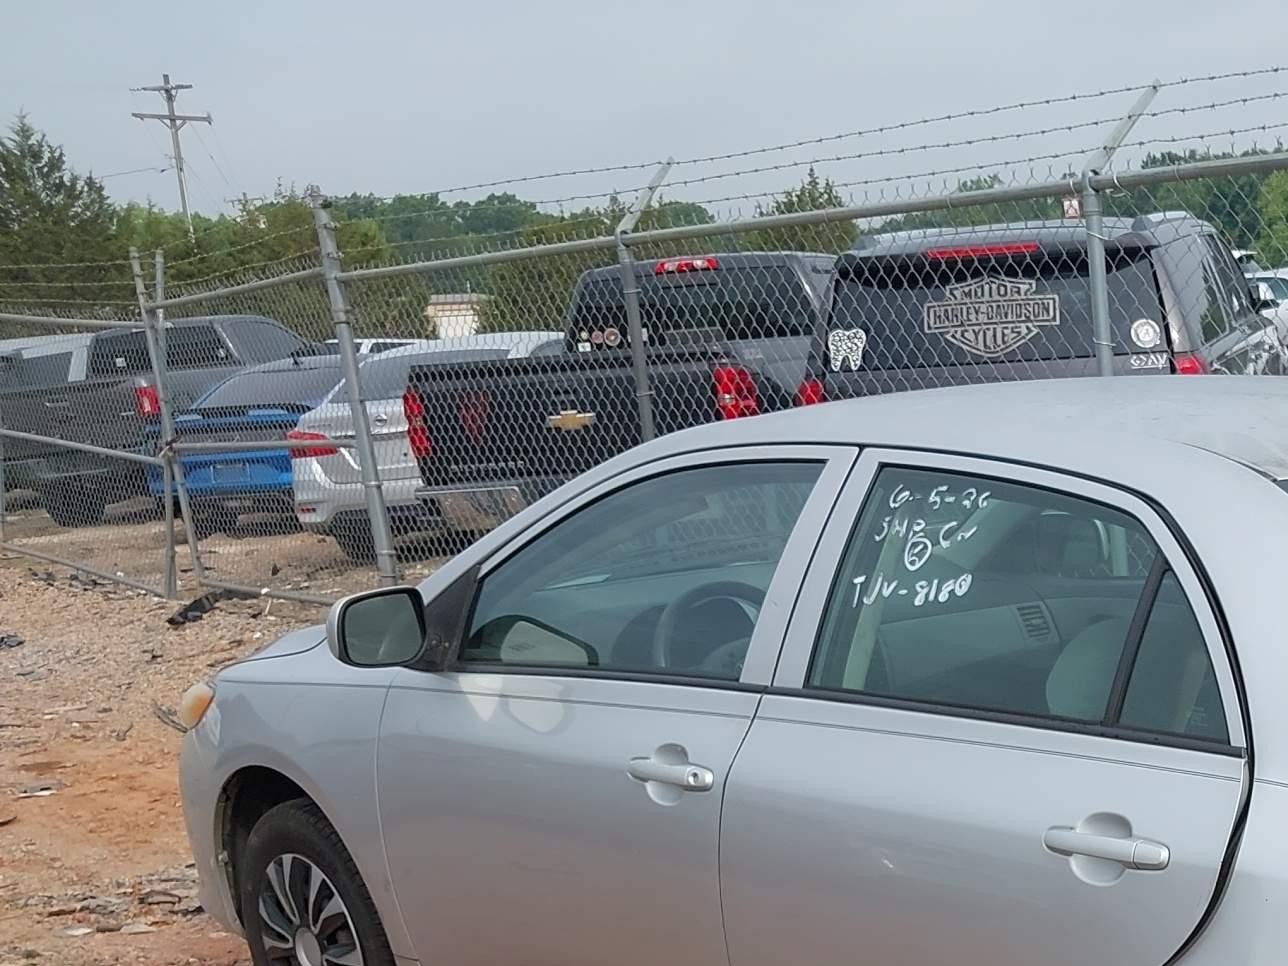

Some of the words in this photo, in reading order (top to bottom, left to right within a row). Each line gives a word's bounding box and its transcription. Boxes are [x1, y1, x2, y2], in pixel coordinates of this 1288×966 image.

[961, 281, 1021, 300] MOTOR
[933, 300, 1051, 325] HARLEY-DAVIDSON
[961, 324, 1022, 351] CYCLES
